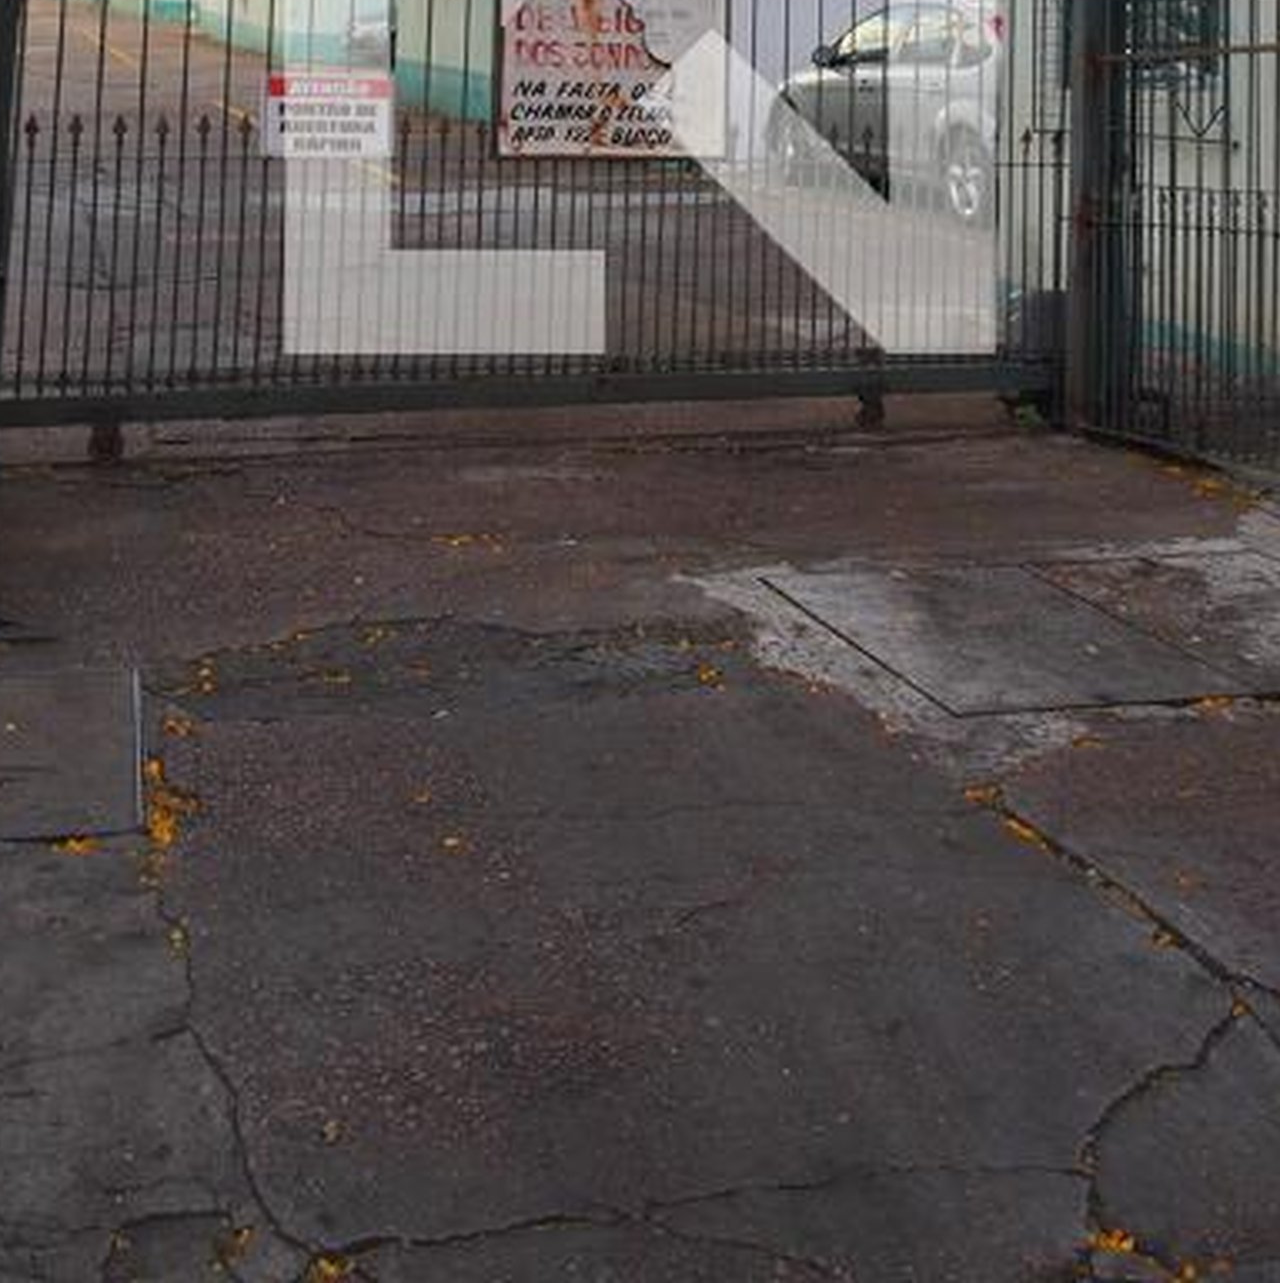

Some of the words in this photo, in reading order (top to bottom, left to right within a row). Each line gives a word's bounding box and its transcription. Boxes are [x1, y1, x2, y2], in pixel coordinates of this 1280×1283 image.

[512, 80, 547, 98] NA
[556, 81, 622, 100] FALTA
[510, 102, 598, 122] CHAMAR
